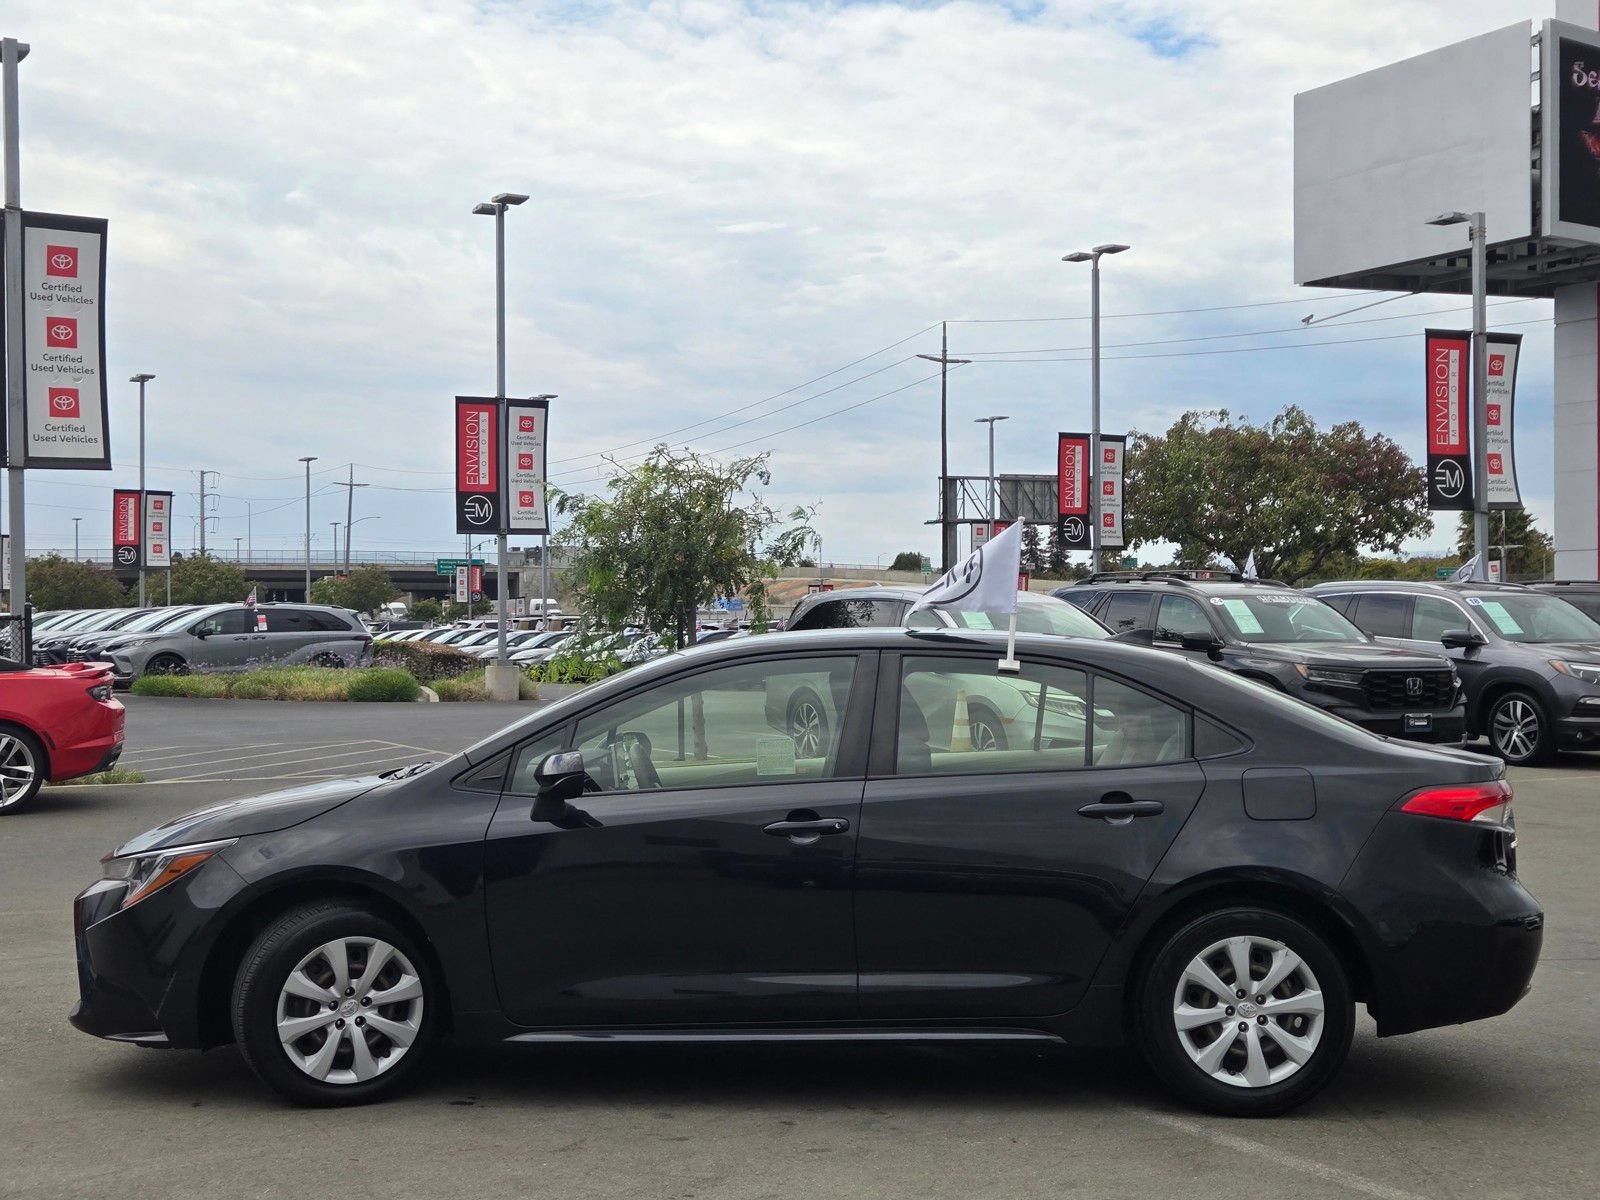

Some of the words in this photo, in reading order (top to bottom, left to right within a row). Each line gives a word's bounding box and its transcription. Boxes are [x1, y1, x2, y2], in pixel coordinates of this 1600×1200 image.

[41, 282, 82, 293] Certified
[30, 292, 53, 302] Used
[56, 293, 94, 305] Vehicles
[42, 353, 82, 364] Certified
[31, 364, 54, 373] Used
[57, 364, 94, 375] Vehicles
[1436, 348, 1449, 445] ENVISION
[44, 424, 86, 433] Certified
[33, 434, 56, 442] Used
[60, 434, 98, 444] Vehicles
[466, 411, 479, 485] ENVISION
[1065, 445, 1075, 508] ENVISION
[120, 497, 128, 541] ENVISION
